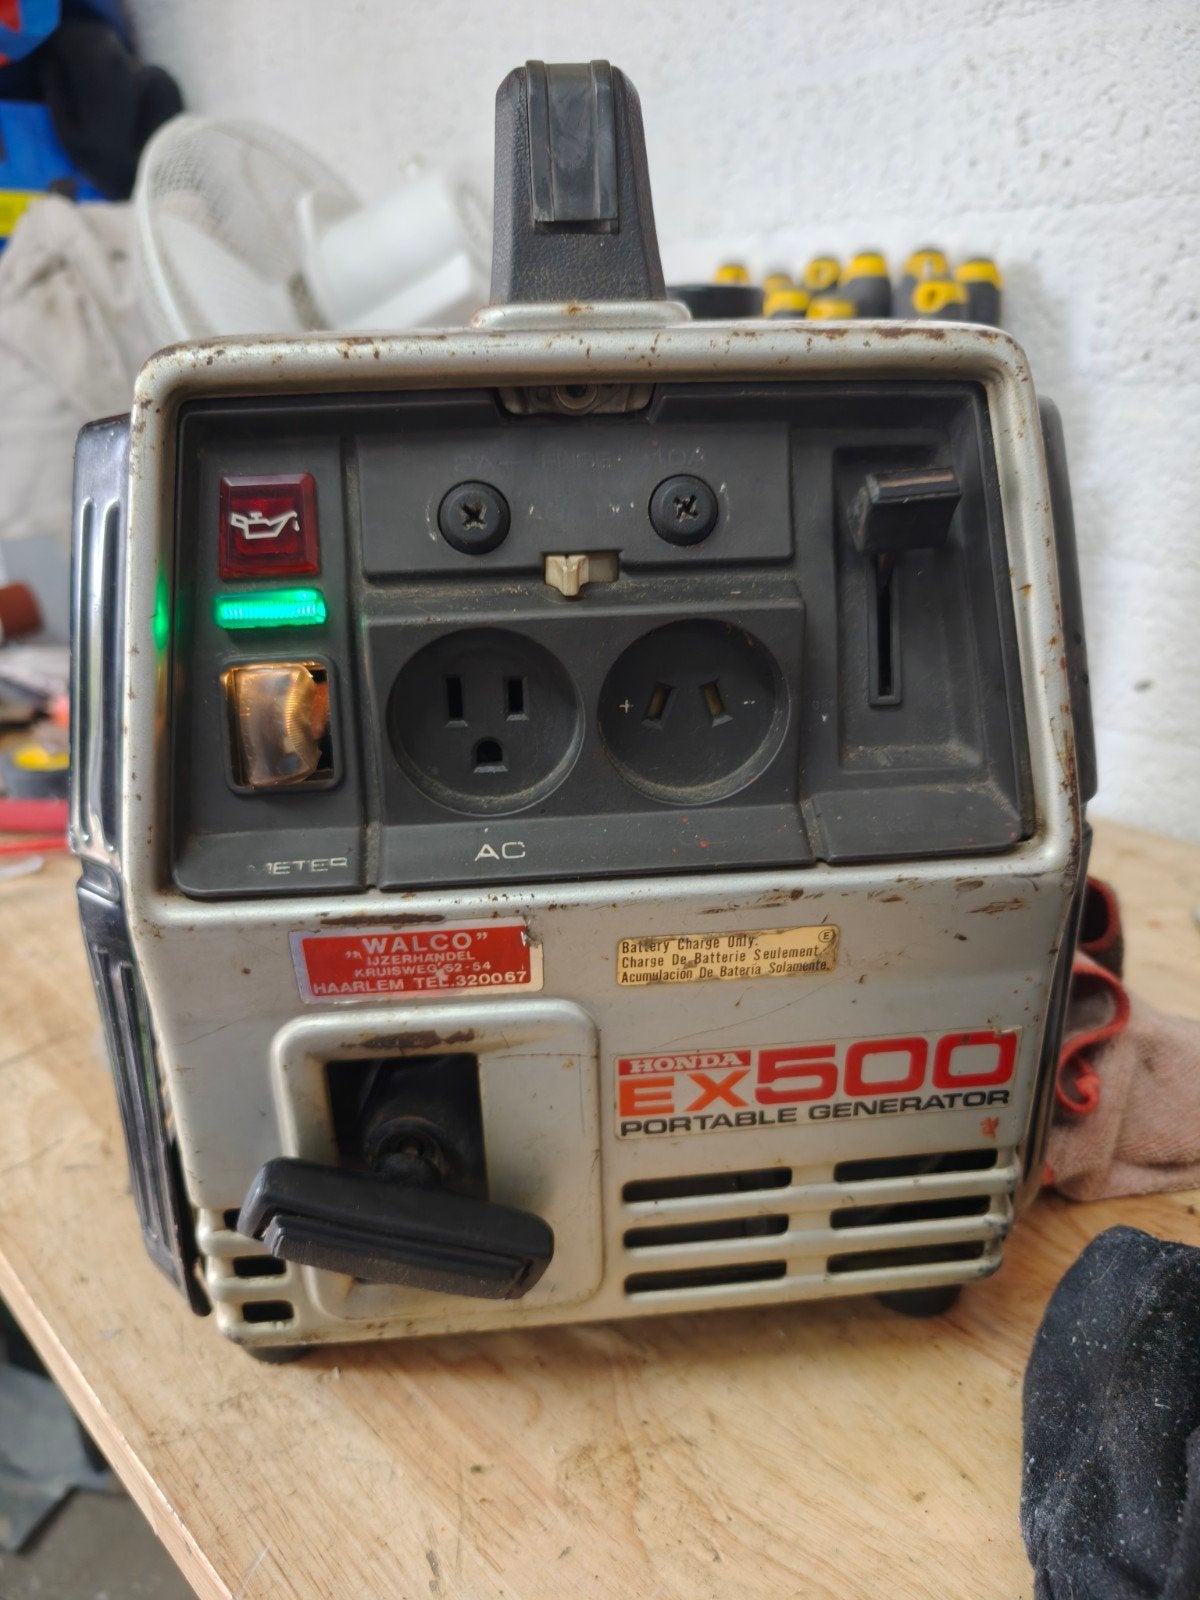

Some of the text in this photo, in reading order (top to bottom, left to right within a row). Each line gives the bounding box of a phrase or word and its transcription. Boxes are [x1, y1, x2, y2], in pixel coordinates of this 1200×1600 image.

[474, 841, 526, 862] AC
[622, 935, 759, 954] Battery Charge Only.
[622, 956, 664, 969] Charge
[672, 954, 687, 966] De
[694, 951, 746, 965] Batterie
[699, 967, 714, 979] De
[768, 960, 830, 974] Solamente.
[354, 963, 438, 978] KRUISWEG
[313, 979, 405, 994] HAARLEM
[630, 1052, 743, 1074] HONDA
[620, 1089, 1009, 1137] PORTABLE GENERATOR
